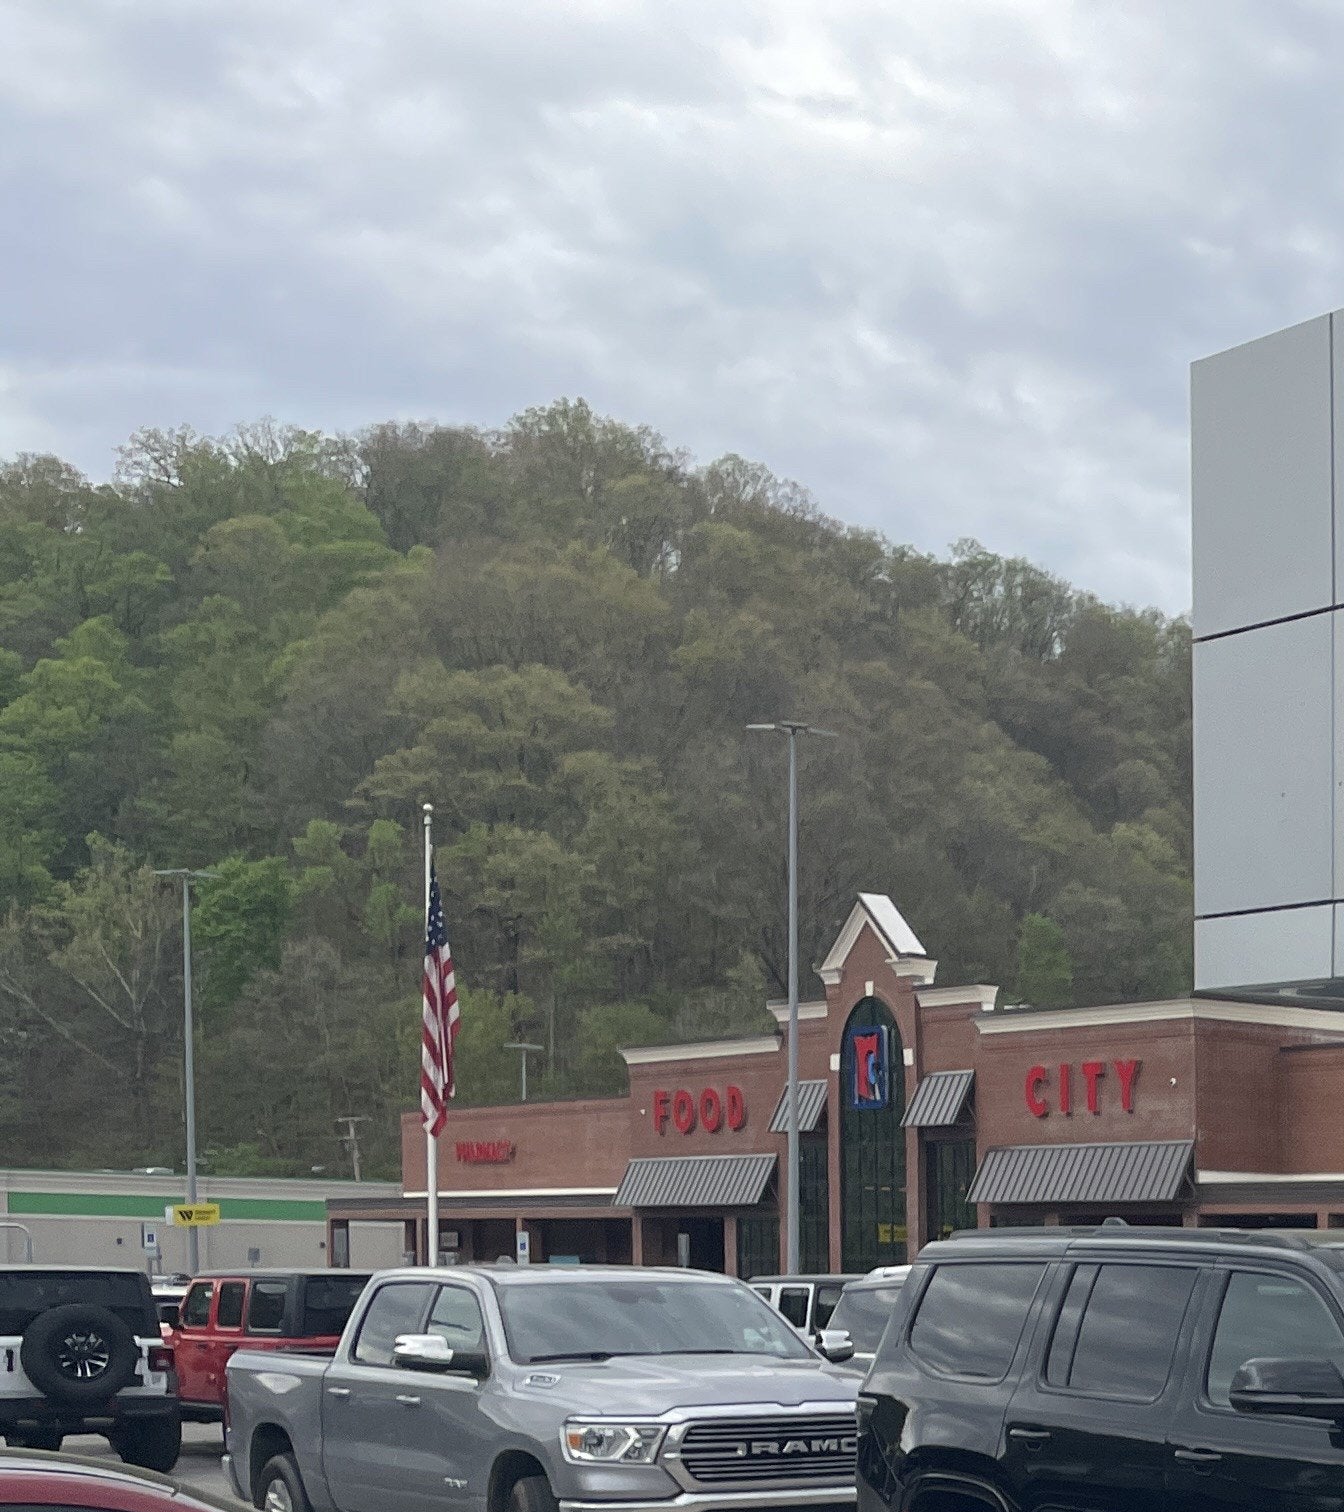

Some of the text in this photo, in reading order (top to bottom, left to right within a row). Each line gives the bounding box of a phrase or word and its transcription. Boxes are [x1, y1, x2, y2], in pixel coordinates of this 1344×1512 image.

[653, 1058, 1139, 1135] FOOD CITY
[751, 1438, 839, 1455] RAM
